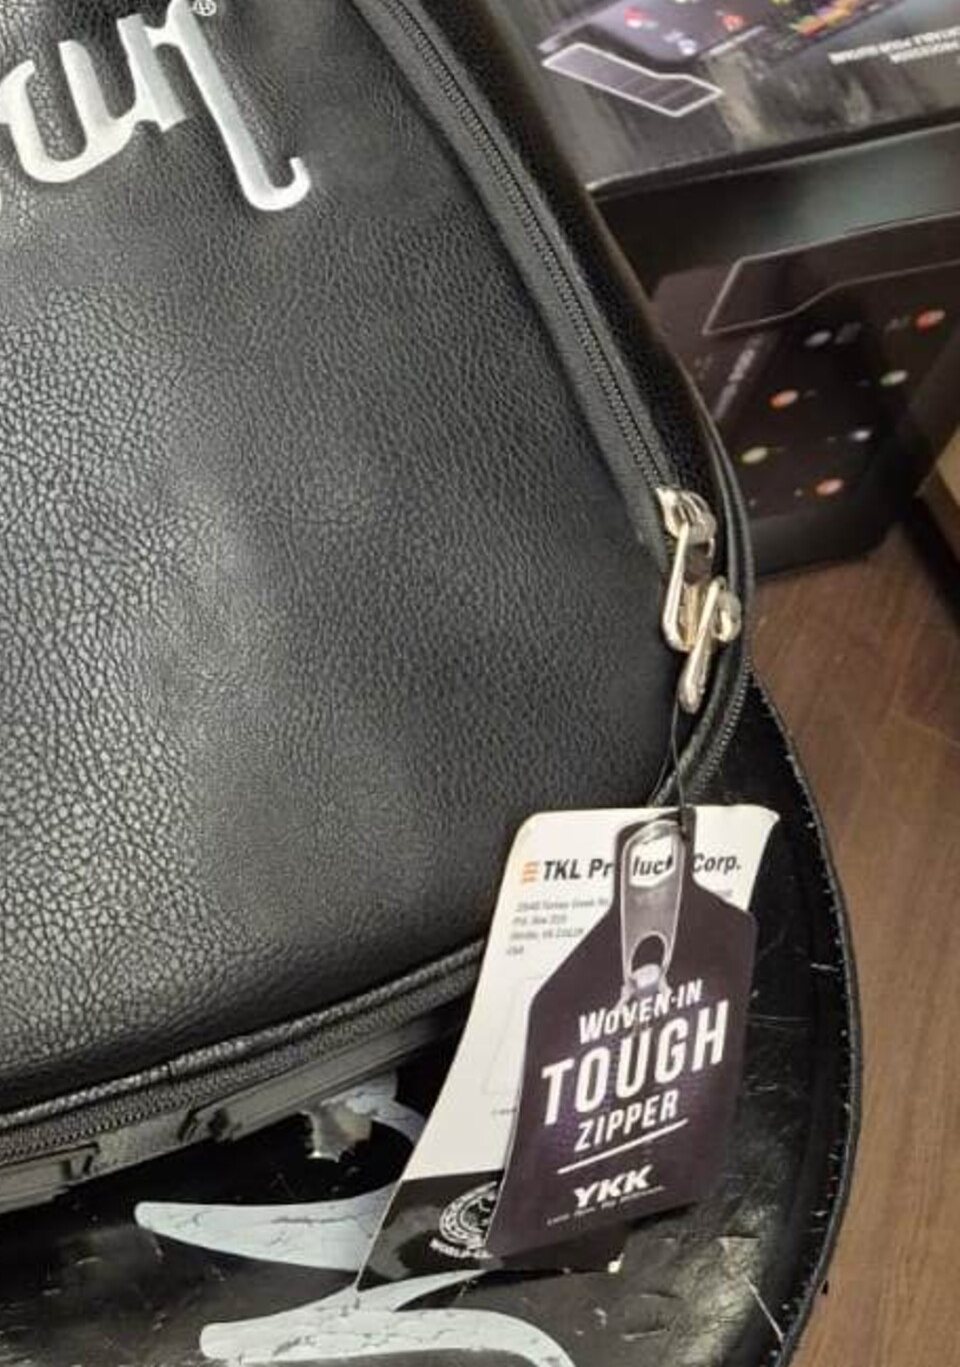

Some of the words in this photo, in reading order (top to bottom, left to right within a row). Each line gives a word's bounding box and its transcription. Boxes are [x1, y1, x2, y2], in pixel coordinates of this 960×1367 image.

[543, 858, 581, 881] TKL
[690, 852, 741, 874] Corp.
[541, 999, 730, 1126] TOUGH
[573, 1089, 680, 1152] ZIPPER
[572, 1164, 654, 1209] YKK
